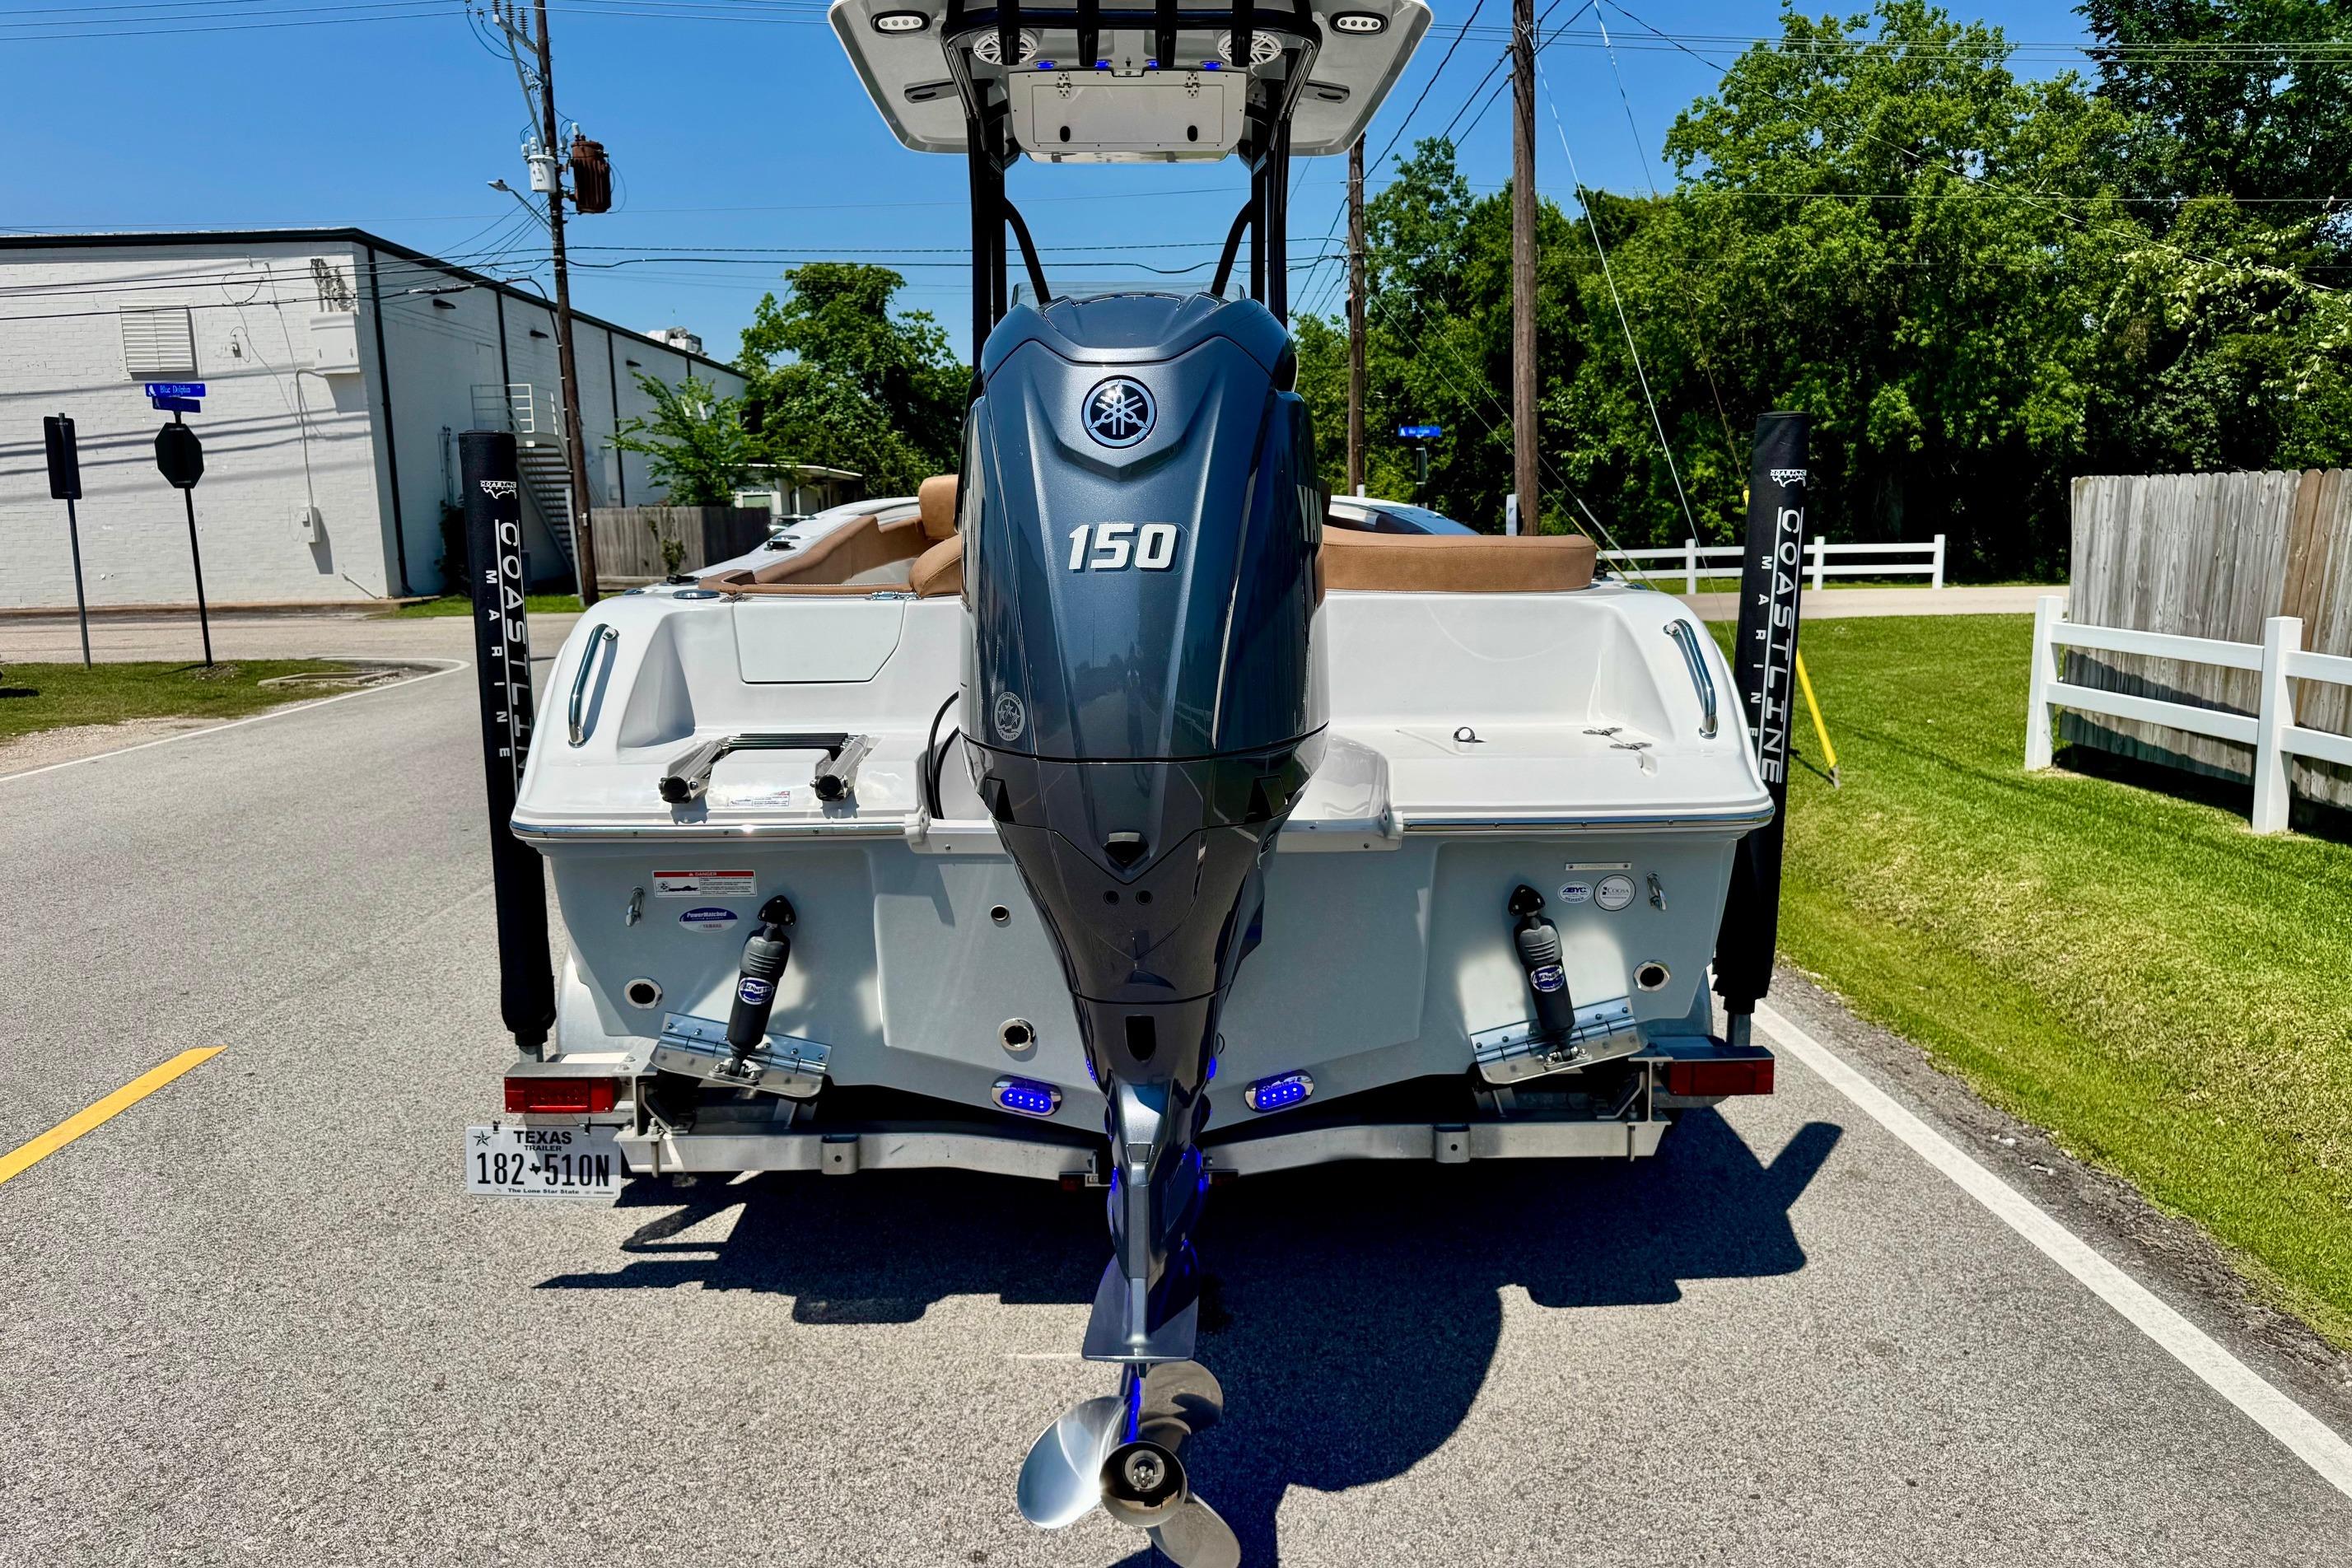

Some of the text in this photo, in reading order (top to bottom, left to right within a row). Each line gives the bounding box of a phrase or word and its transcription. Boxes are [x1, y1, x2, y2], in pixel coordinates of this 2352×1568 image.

[1068, 523, 1181, 574] 150
[485, 569, 511, 758] MARINE
[1748, 555, 1772, 738] MARINE
[1761, 509, 1800, 783] COASTLINE
[477, 1152, 609, 1187] 182 510N
[513, 1130, 572, 1145] TEXAS
